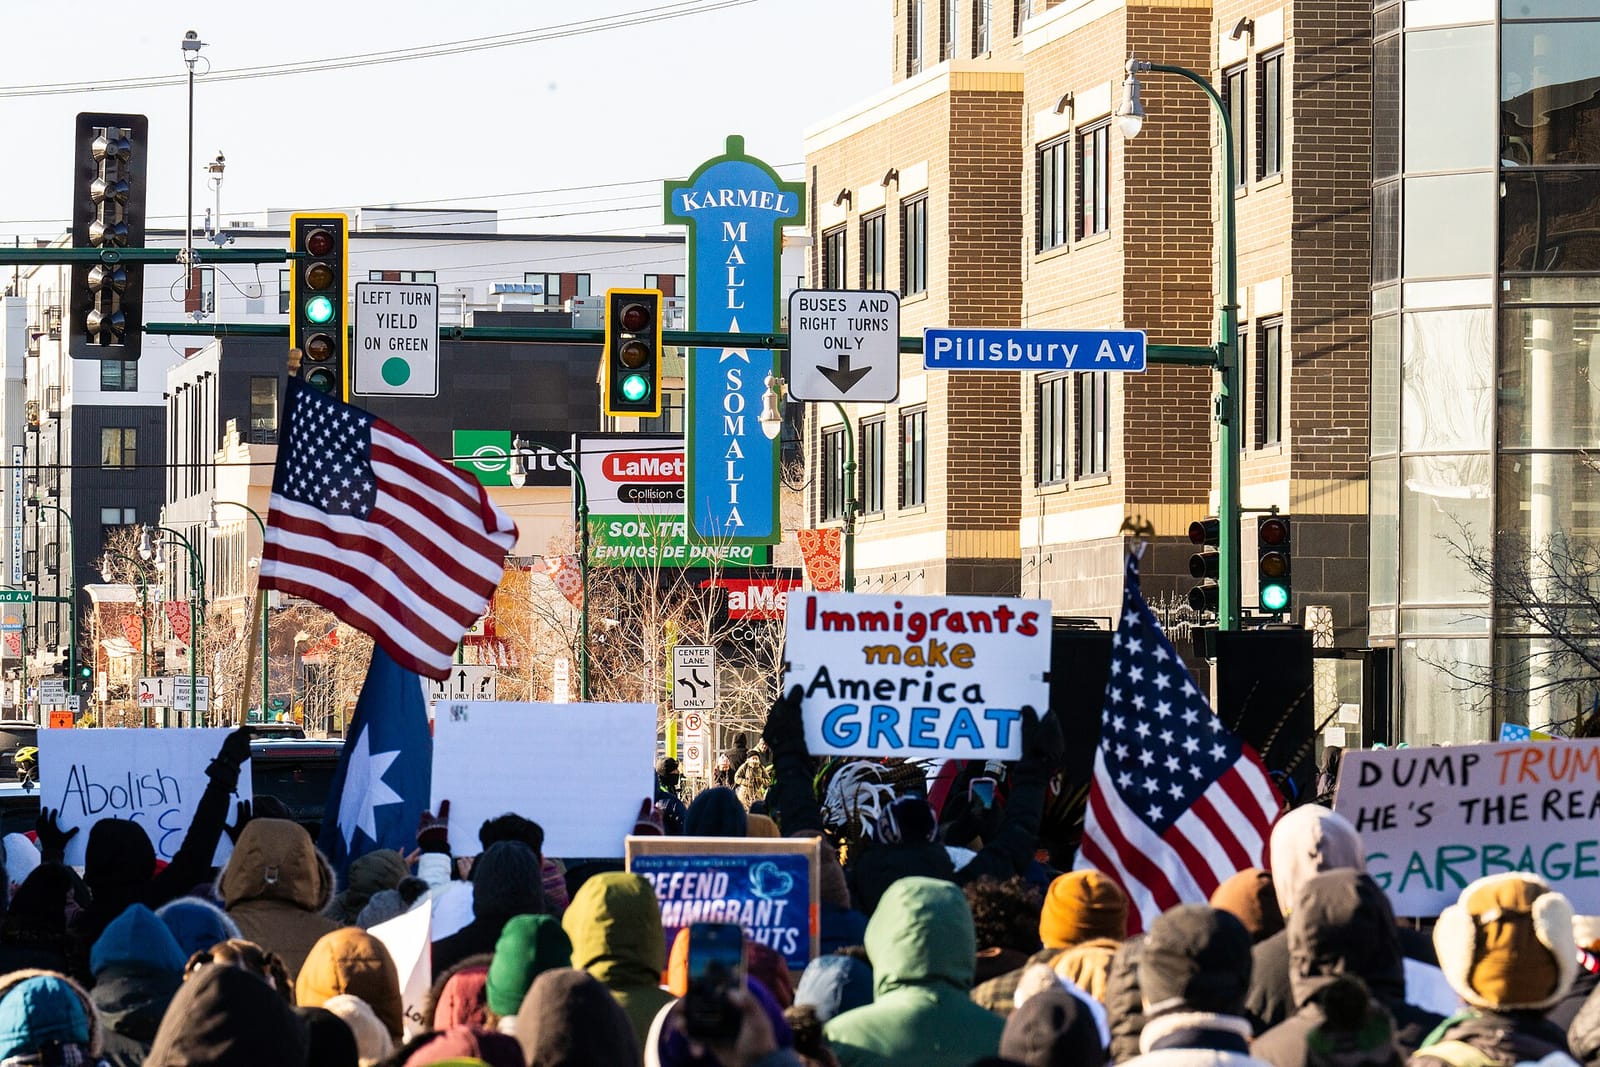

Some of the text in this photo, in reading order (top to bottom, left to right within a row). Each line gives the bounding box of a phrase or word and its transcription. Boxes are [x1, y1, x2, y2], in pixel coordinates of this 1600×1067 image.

[680, 188, 790, 214] KARMEL
[362, 291, 432, 306] LEFT TURN
[799, 298, 889, 312] BUSES AND
[376, 313, 418, 329] YIELD
[800, 318, 888, 332] RIGHT TURNS
[364, 337, 428, 351] ON GREEN
[824, 336, 864, 350] ONLY
[934, 338, 1136, 368] Pillsbury Av
[722, 222, 748, 526] MALL SOMALIA
[628, 489, 672, 500] Collision
[608, 522, 650, 538] SOL
[596, 546, 753, 558] ENVIOS DE DINERO
[806, 596, 1038, 643] Immigrants
[862, 638, 976, 668] make
[805, 665, 985, 704] America
[822, 704, 1022, 749] GREAT
[1358, 754, 1481, 788] DUMP
[59, 764, 181, 818] Abolish
[1356, 802, 1435, 832] HE'S
[1458, 794, 1528, 825] THE
[1365, 840, 1600, 893] GARBAGE
[659, 900, 788, 928] MMIGRANT
